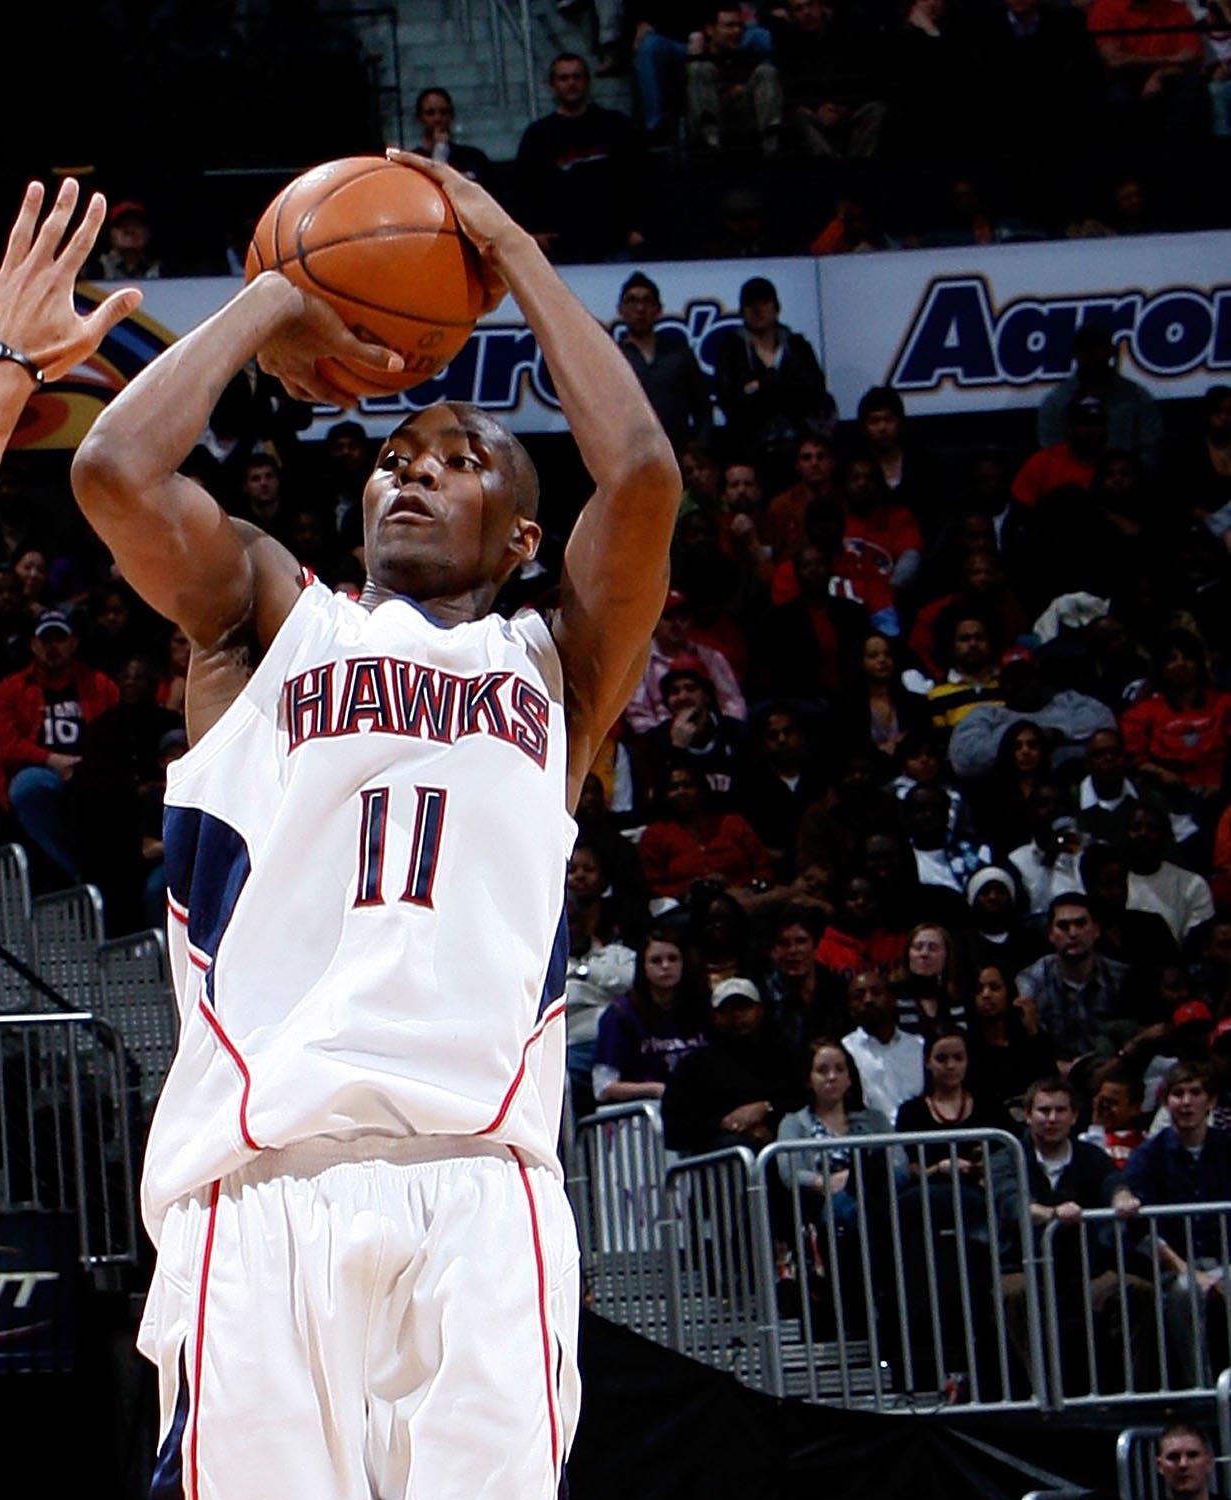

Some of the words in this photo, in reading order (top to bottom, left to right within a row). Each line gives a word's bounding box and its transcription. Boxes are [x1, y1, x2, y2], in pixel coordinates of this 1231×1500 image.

[884, 276, 1231, 391] Aaro
[44, 718, 80, 746] 10
[284, 656, 549, 770] HAWKS
[351, 785, 447, 909] 11
